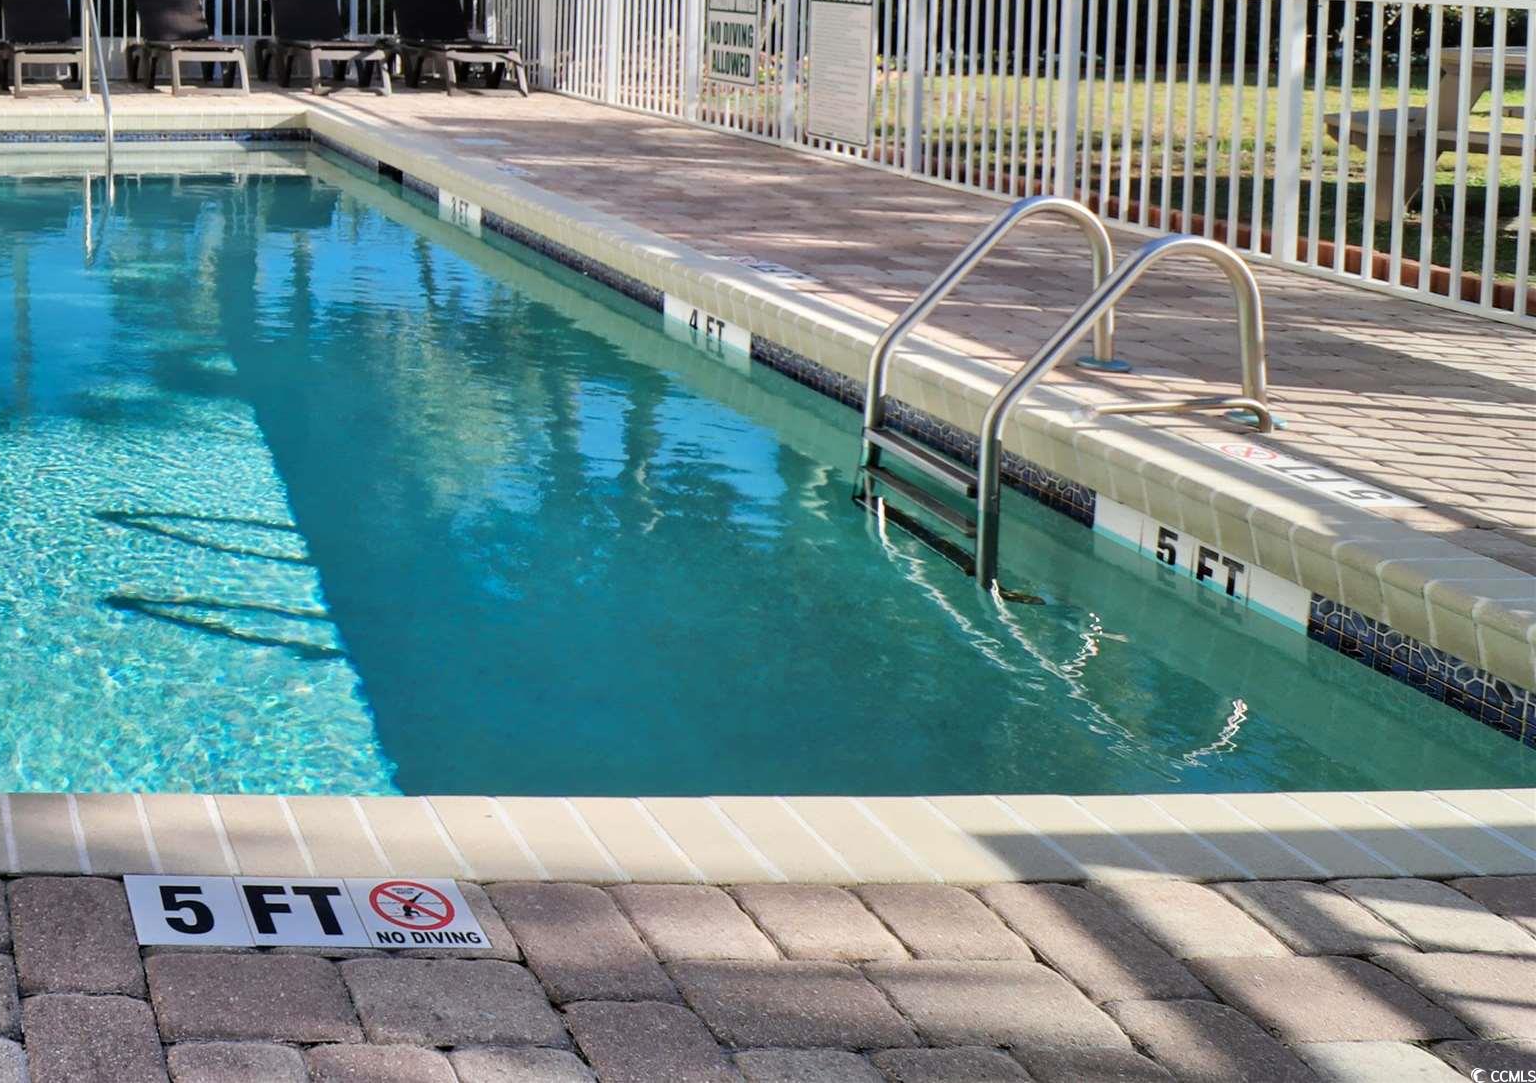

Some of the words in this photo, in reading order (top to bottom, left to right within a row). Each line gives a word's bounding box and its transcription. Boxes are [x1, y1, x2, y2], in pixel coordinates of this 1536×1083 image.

[711, 20, 721, 44] NO
[723, 22, 754, 48] DIVING
[712, 50, 751, 78] ALLOWED
[689, 308, 698, 330] 4
[706, 315, 725, 341] FT
[1264, 464, 1352, 483] FT
[1333, 489, 1394, 500] 5
[1156, 526, 1179, 565] 5
[1196, 545, 1245, 597] FT
[159, 885, 215, 935] 5
[242, 885, 344, 936] FT
[375, 931, 405, 944] NO
[410, 931, 482, 944] DIVING
